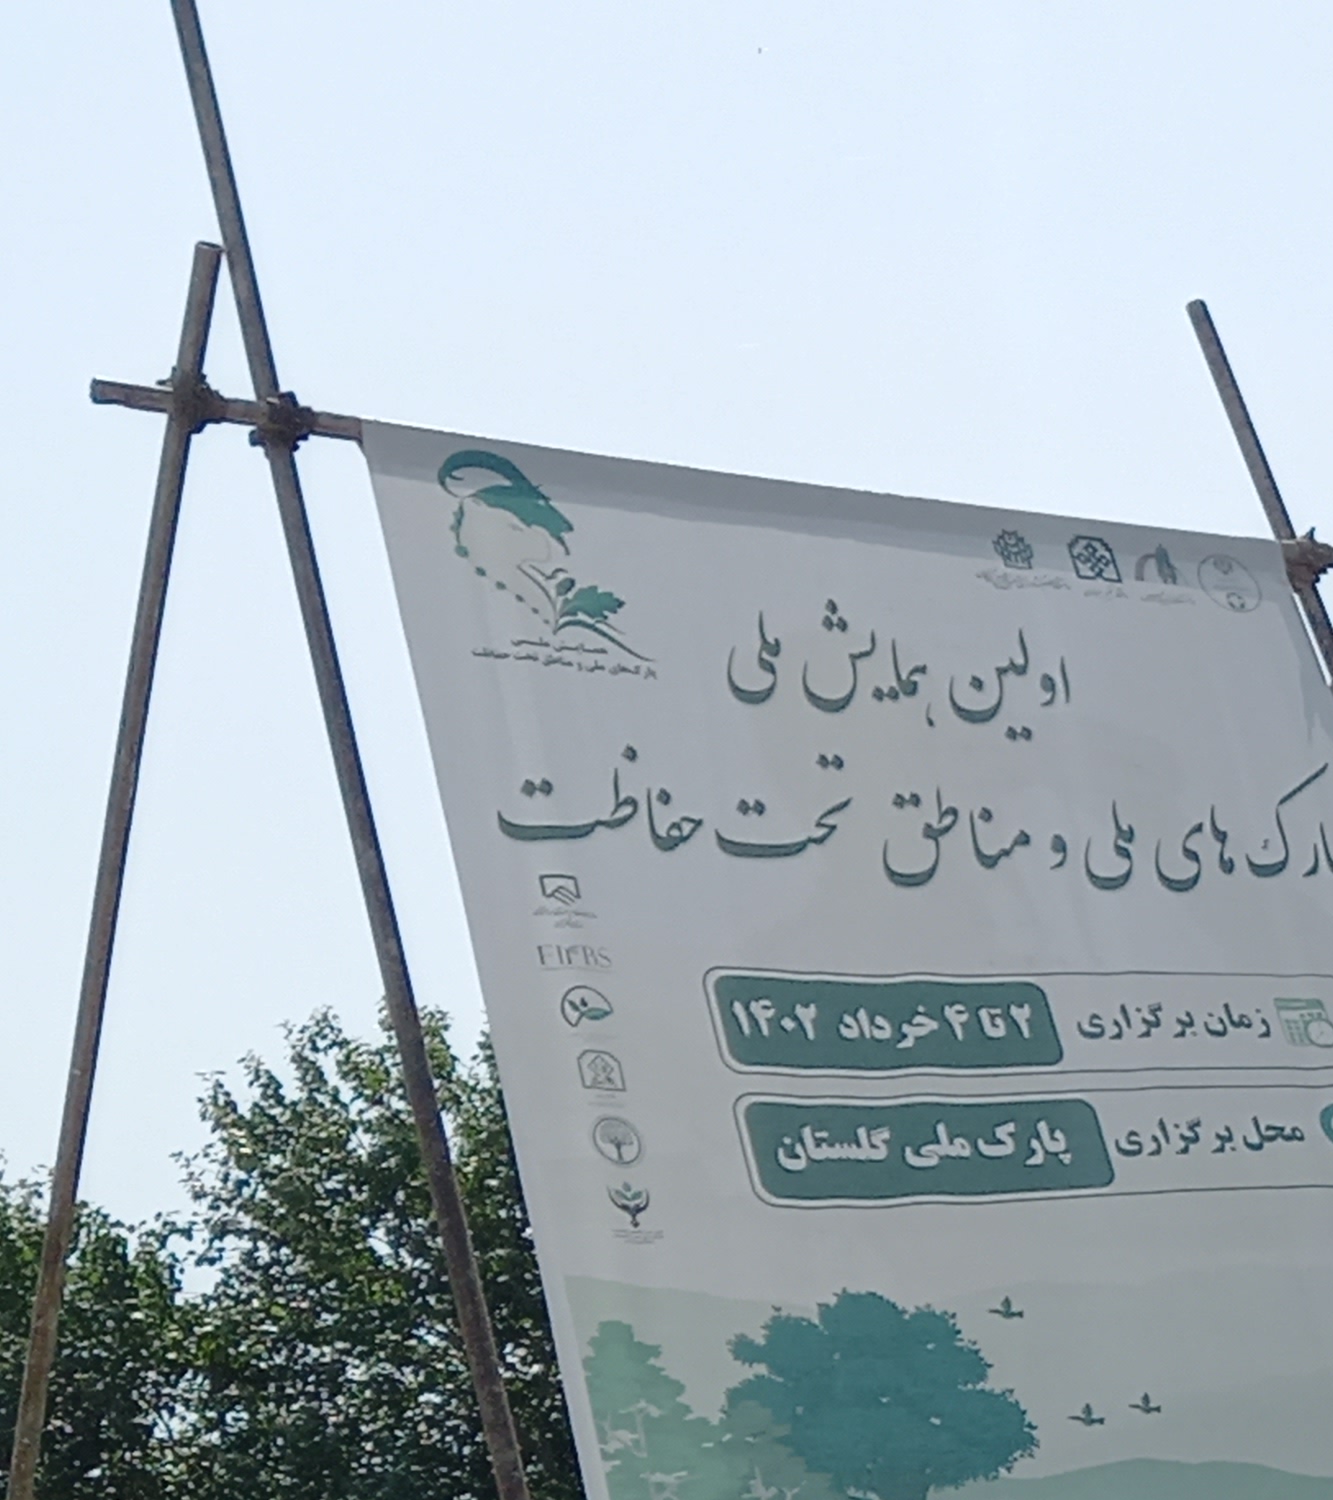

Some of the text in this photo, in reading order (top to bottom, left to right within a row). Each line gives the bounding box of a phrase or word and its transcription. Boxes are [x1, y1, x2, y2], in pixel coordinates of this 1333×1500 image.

[726, 599, 1070, 743] اولین همایش ملی
[496, 744, 704, 853] حفاظت
[714, 752, 853, 858] تحت
[882, 788, 1031, 887] مناطق
[1048, 829, 1069, 869] و
[1084, 800, 1137, 890] ملی
[838, 1006, 939, 1049] خرداد
[944, 1003, 969, 1041] ۴
[978, 1006, 1005, 1040] تا
[1204, 1004, 1271, 1040] زمان
[774, 1119, 1073, 1172] پارک ملی گلستان
[1241, 1119, 1305, 1151] محل
